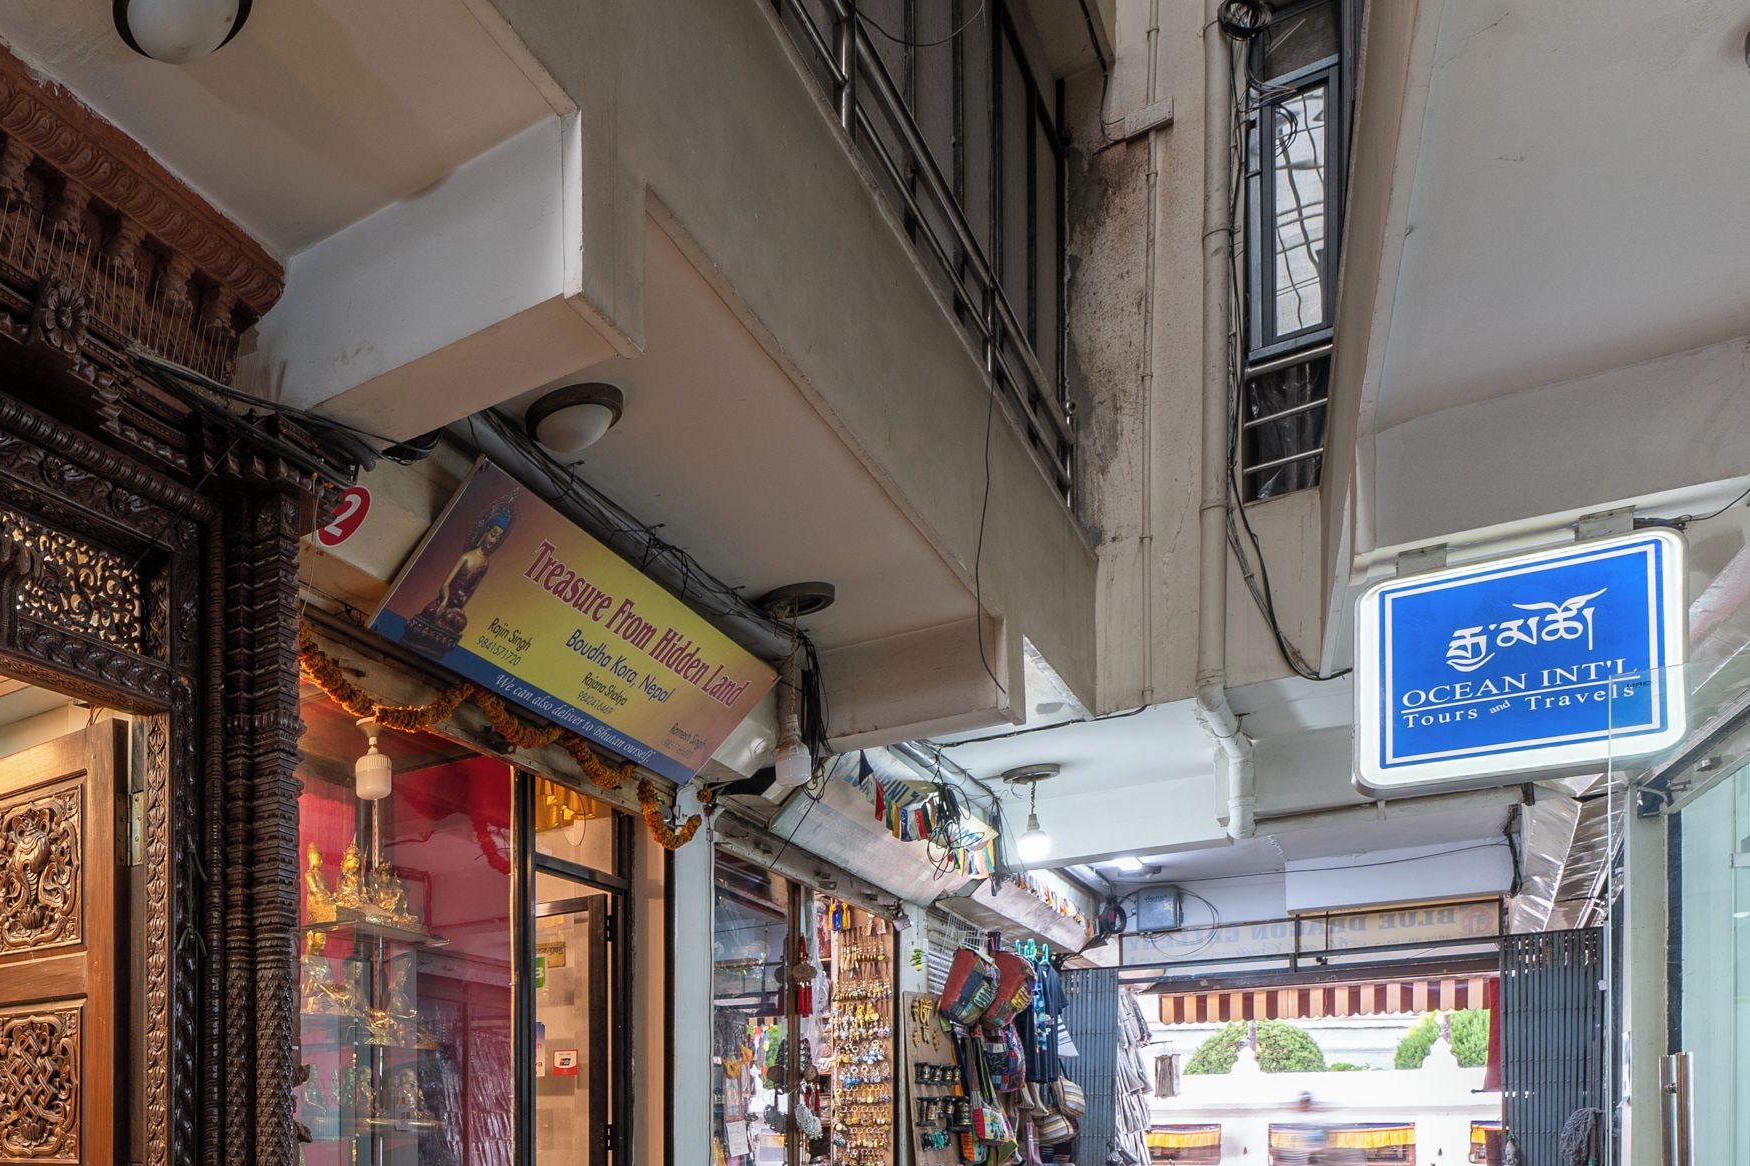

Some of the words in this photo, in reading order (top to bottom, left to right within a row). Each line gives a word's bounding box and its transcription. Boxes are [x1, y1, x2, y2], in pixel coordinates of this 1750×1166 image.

[324, 493, 362, 537] 2
[508, 629, 532, 652] Singh
[522, 539, 613, 623] Treasure
[604, 597, 657, 652] From
[648, 627, 712, 686] Hidden
[700, 664, 749, 707] Land
[565, 628, 613, 668] Boudha
[610, 655, 639, 689] Kora,
[639, 673, 676, 704] Nepal
[1402, 672, 1527, 708] OCEAN
[1403, 707, 1478, 729] Tours
[1489, 699, 1510, 715] and
[1525, 684, 1635, 711] Travels
[495, 673, 515, 691] We
[512, 685, 533, 701] can
[531, 693, 553, 711] also
[551, 704, 586, 727] deliver
[583, 720, 595, 732] to
[593, 725, 626, 748] Bhutan
[622, 742, 657, 765] ourself.
